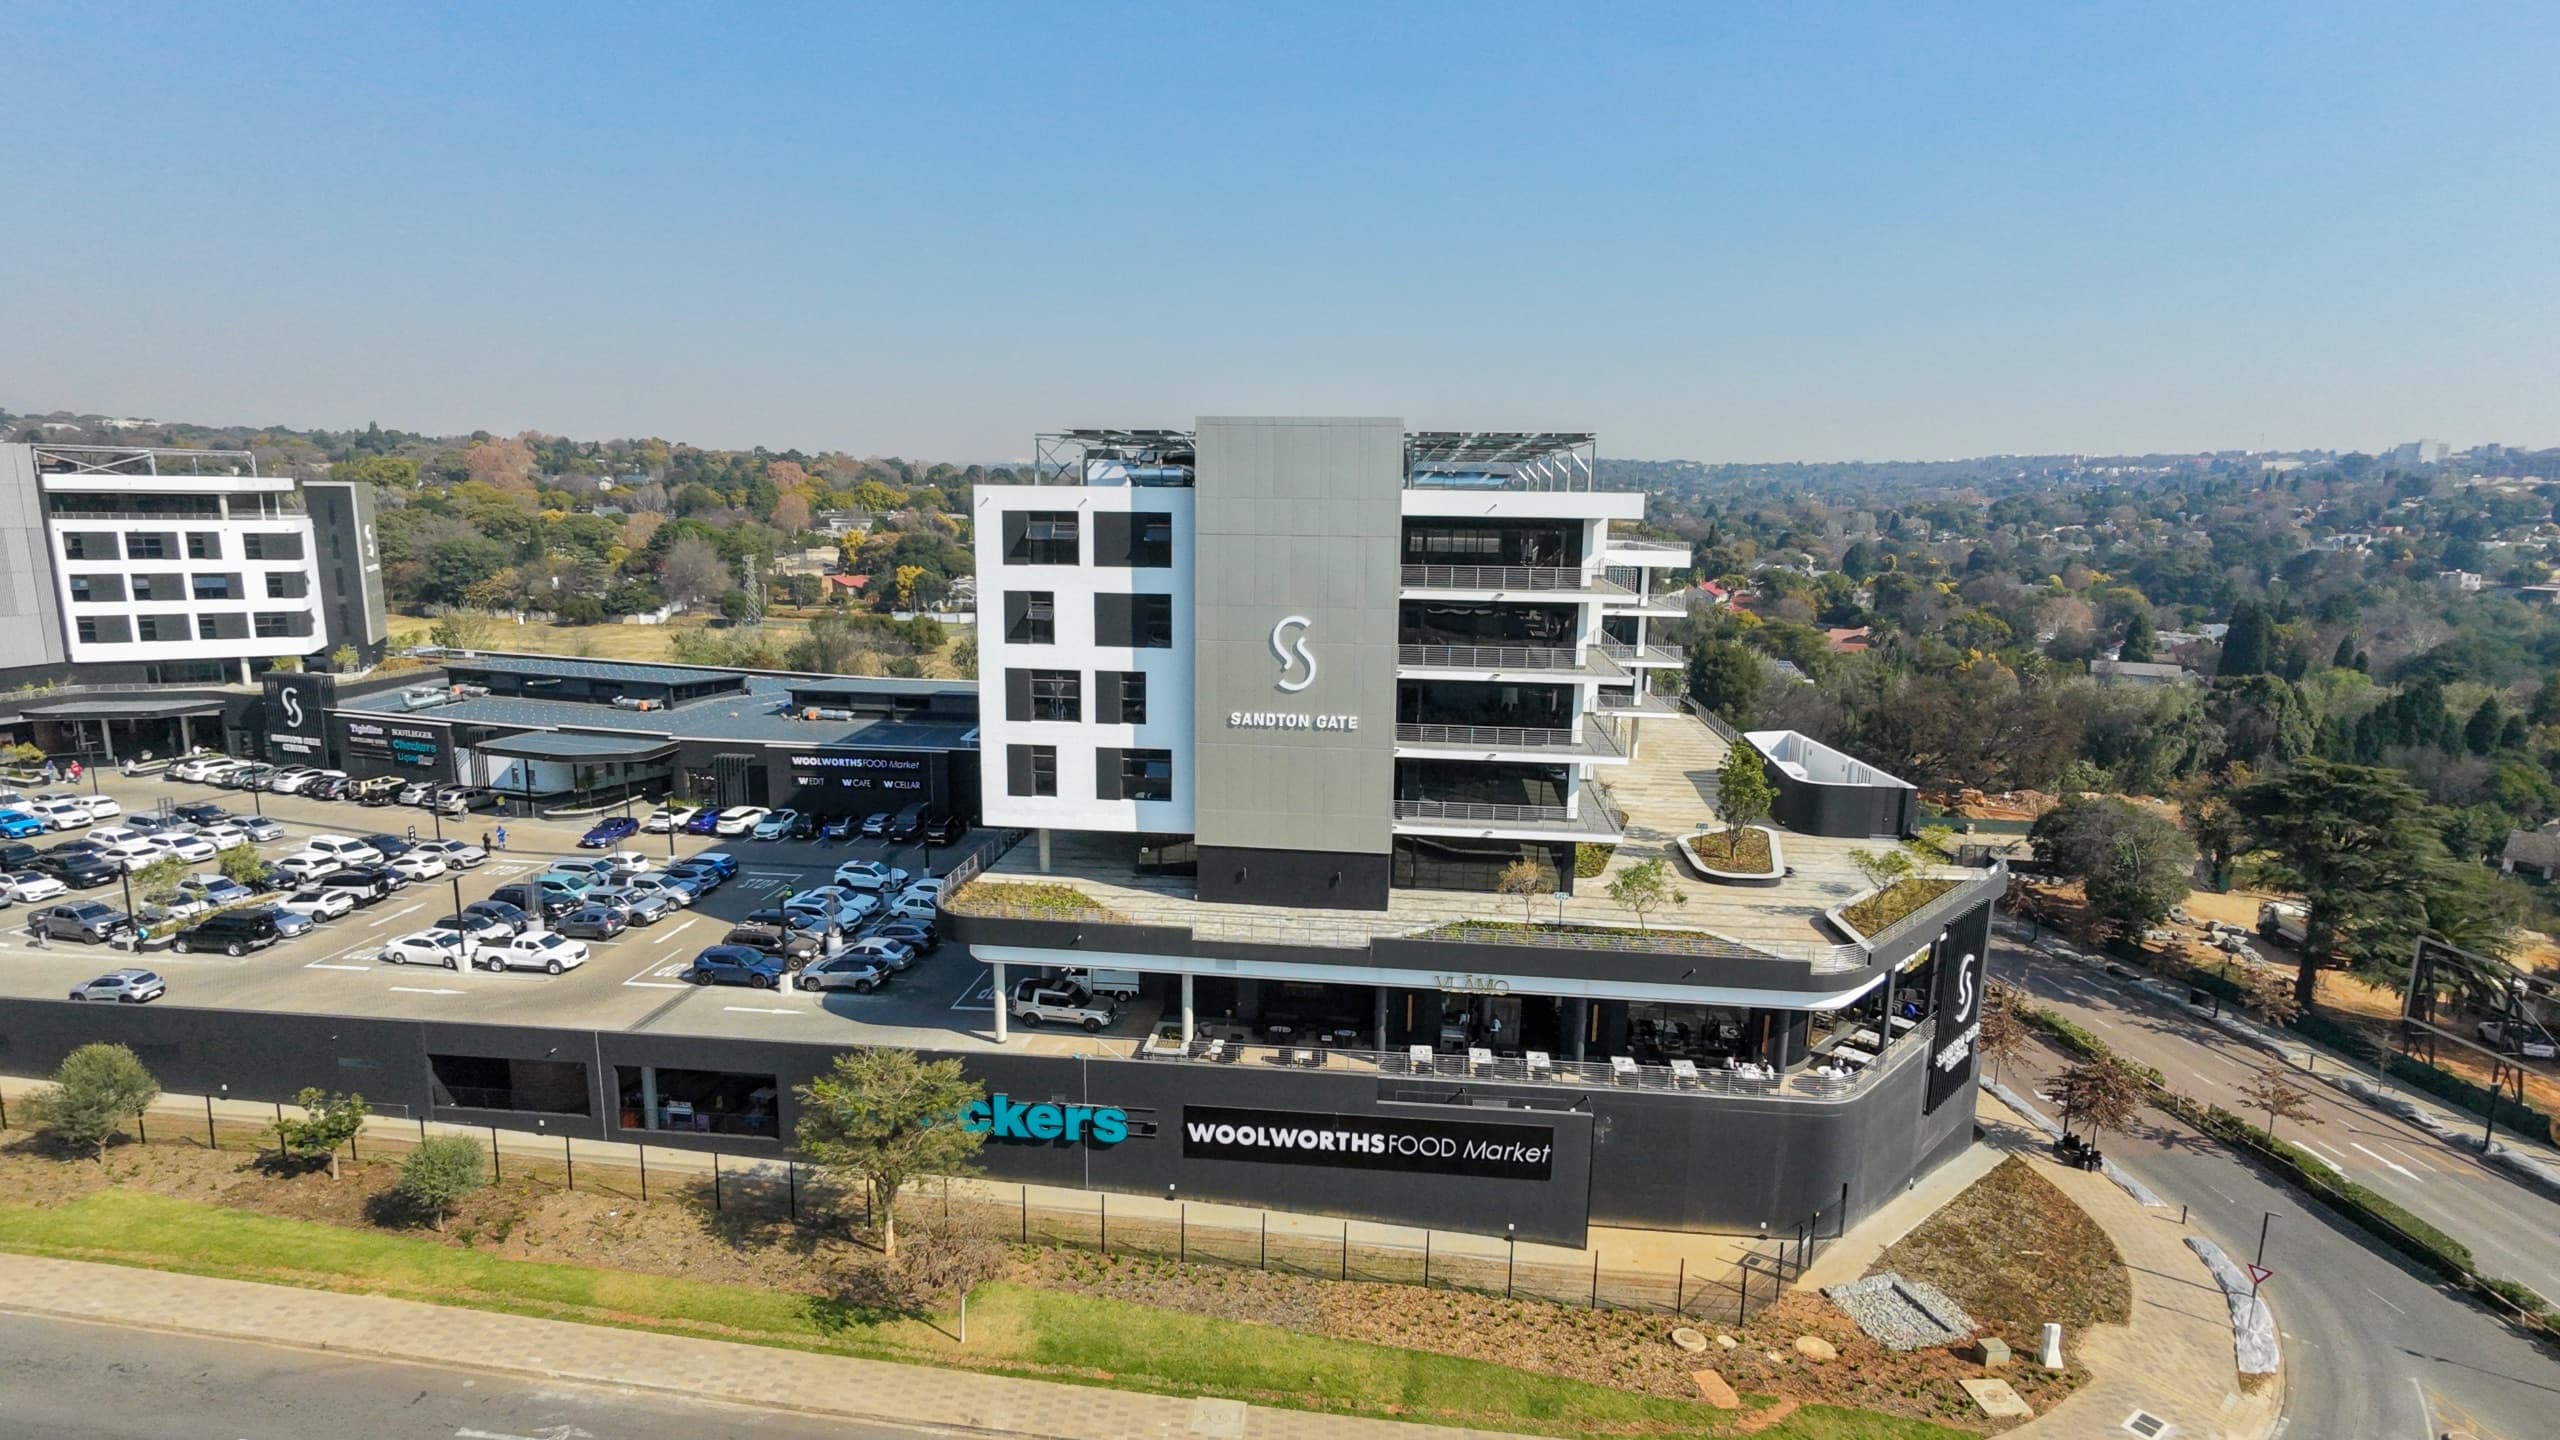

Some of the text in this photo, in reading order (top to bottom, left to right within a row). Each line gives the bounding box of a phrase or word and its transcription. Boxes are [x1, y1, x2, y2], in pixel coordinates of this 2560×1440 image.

[1230, 711, 1359, 730] SANDTON GATE
[392, 739, 437, 753] Checkers
[791, 756, 862, 768] WOOLWORTHS
[889, 761, 920, 770] Market
[737, 878, 781, 889] STOP
[920, 1092, 1129, 1144] ckers
[1187, 1122, 1552, 1164] WOOLWORTHS FOOD Market
